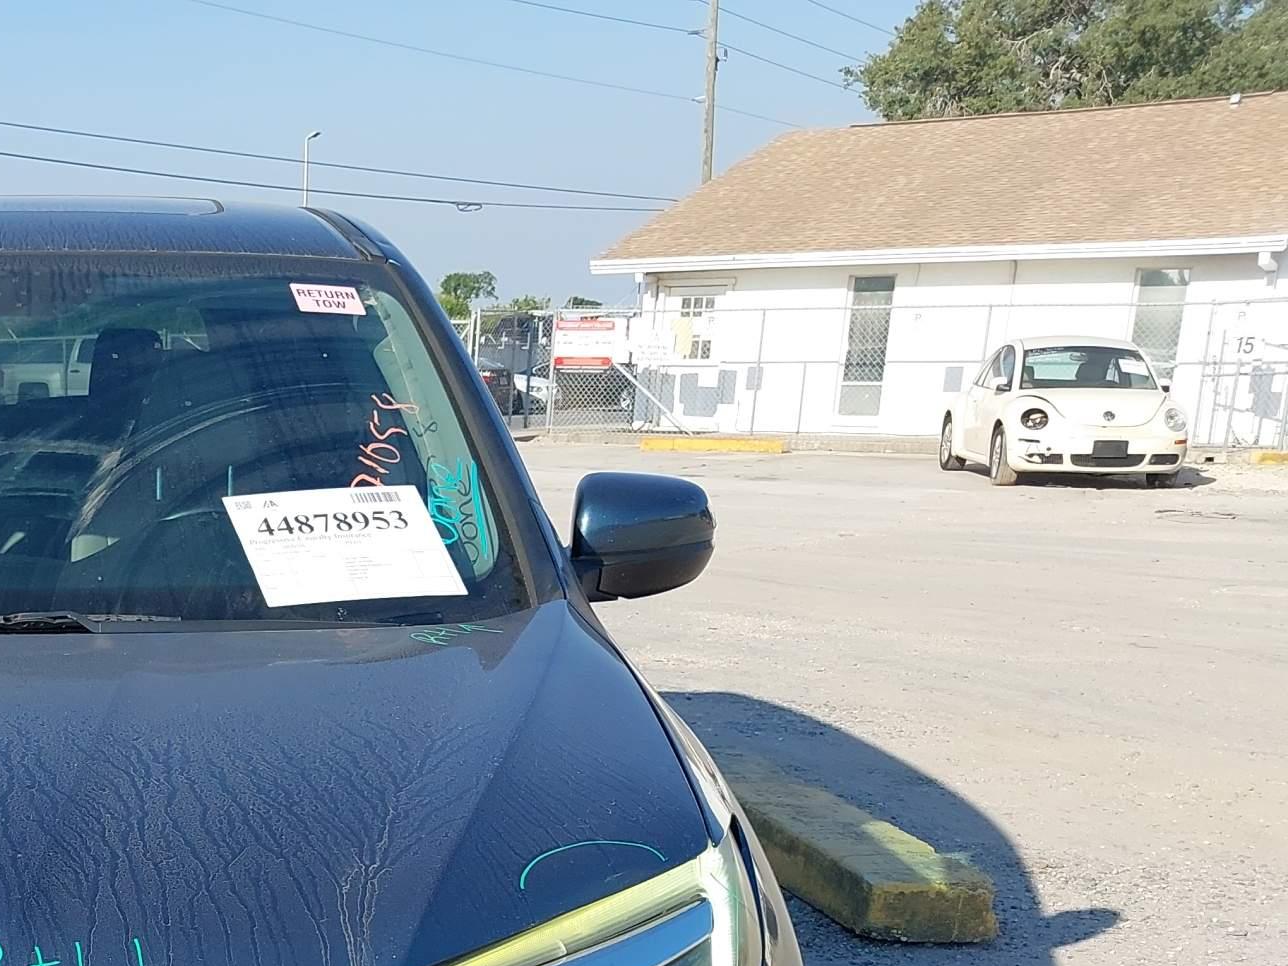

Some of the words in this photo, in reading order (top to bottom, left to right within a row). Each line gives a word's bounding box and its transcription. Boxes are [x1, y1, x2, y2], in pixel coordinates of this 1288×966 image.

[296, 288, 356, 301] RETURN
[312, 299, 347, 309] TOW
[1235, 336, 1257, 355] 15
[257, 509, 409, 537] 44878953
